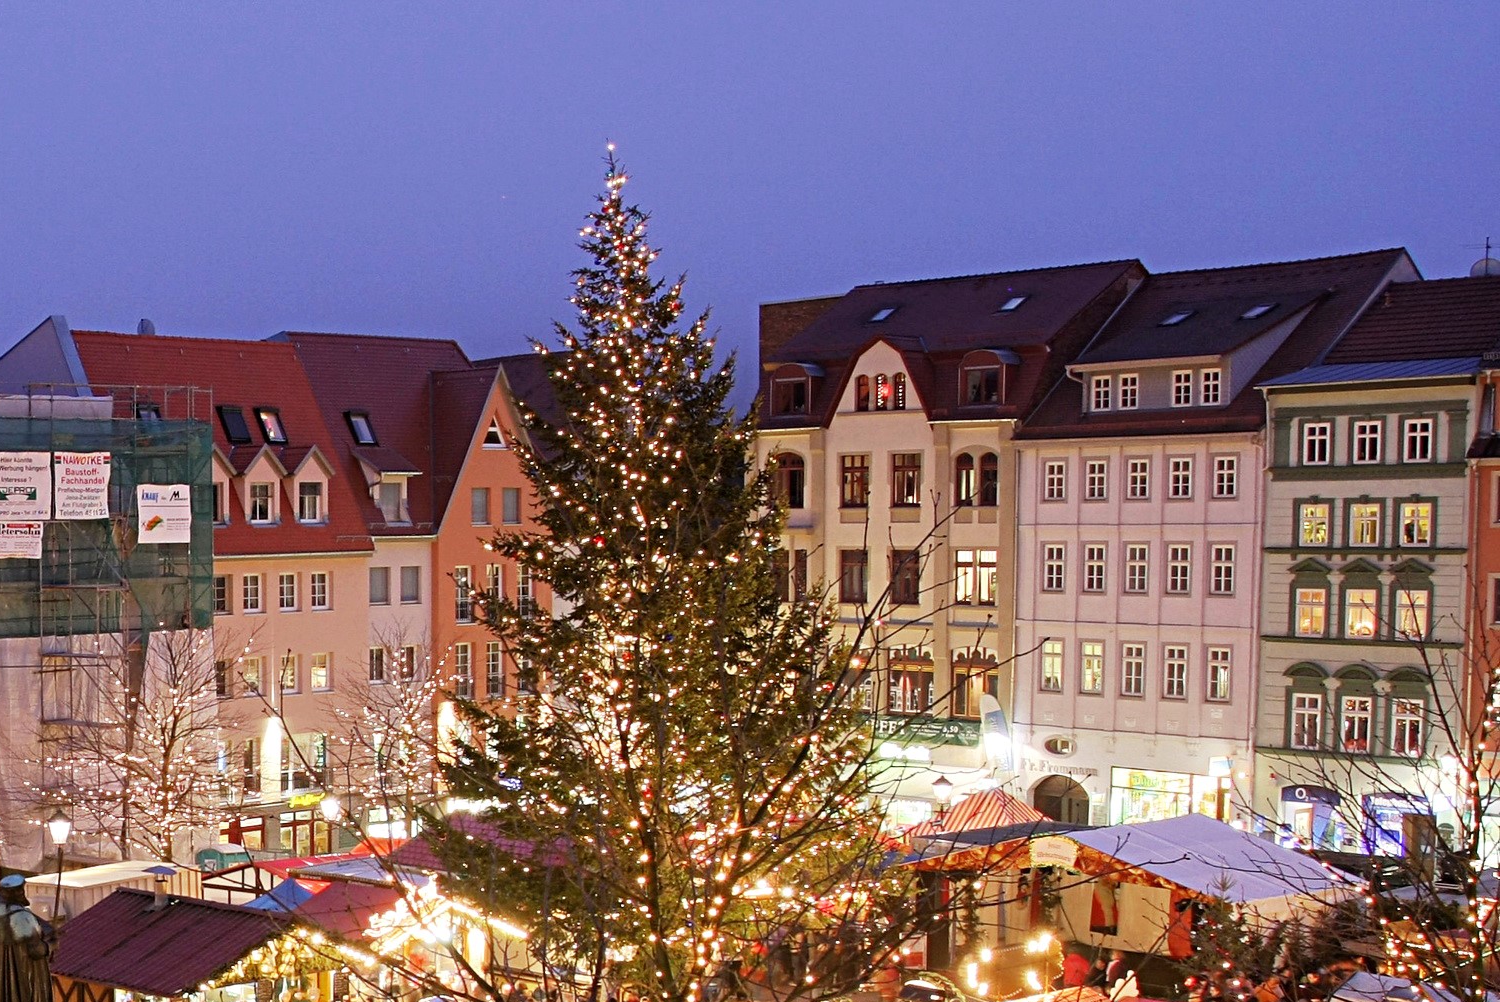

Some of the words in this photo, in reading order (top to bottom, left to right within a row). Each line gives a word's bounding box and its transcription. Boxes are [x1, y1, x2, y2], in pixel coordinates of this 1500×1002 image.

[62, 455, 102, 465] NAWOTKE
[65, 467, 100, 476] Baustoff-
[61, 476, 105, 485] Fachhandel
